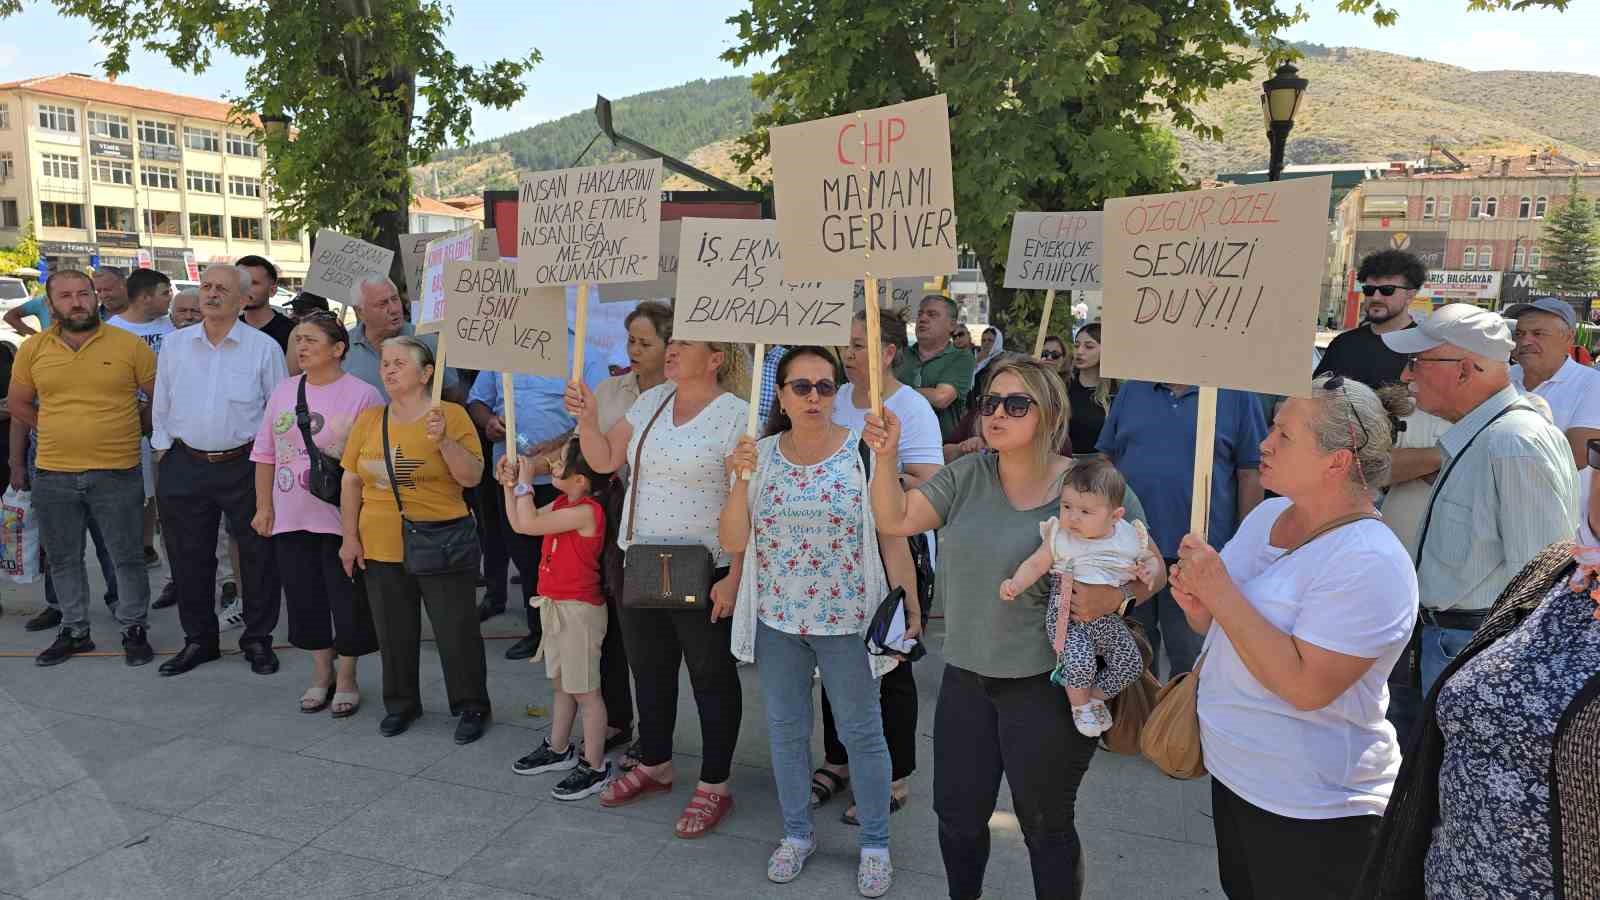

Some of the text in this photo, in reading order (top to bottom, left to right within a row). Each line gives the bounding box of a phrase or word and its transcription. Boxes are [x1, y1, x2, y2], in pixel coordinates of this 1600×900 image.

[836, 117, 907, 165] CHP
[576, 167, 655, 195] HAKLARINI
[823, 167, 932, 211] MAMAMI
[534, 200, 584, 224] İNKAR
[1125, 191, 1281, 235] ÖZGÜR ÖZEL
[1038, 215, 1088, 240] CHP
[555, 237, 629, 264] MEYDAN
[1125, 236, 1259, 280] SESİMİZİ
[731, 263, 768, 292] AŞ
[477, 294, 521, 320] İŞİNİ
[1133, 284, 1264, 335] DUY!!!
[456, 316, 503, 346] GERİ
